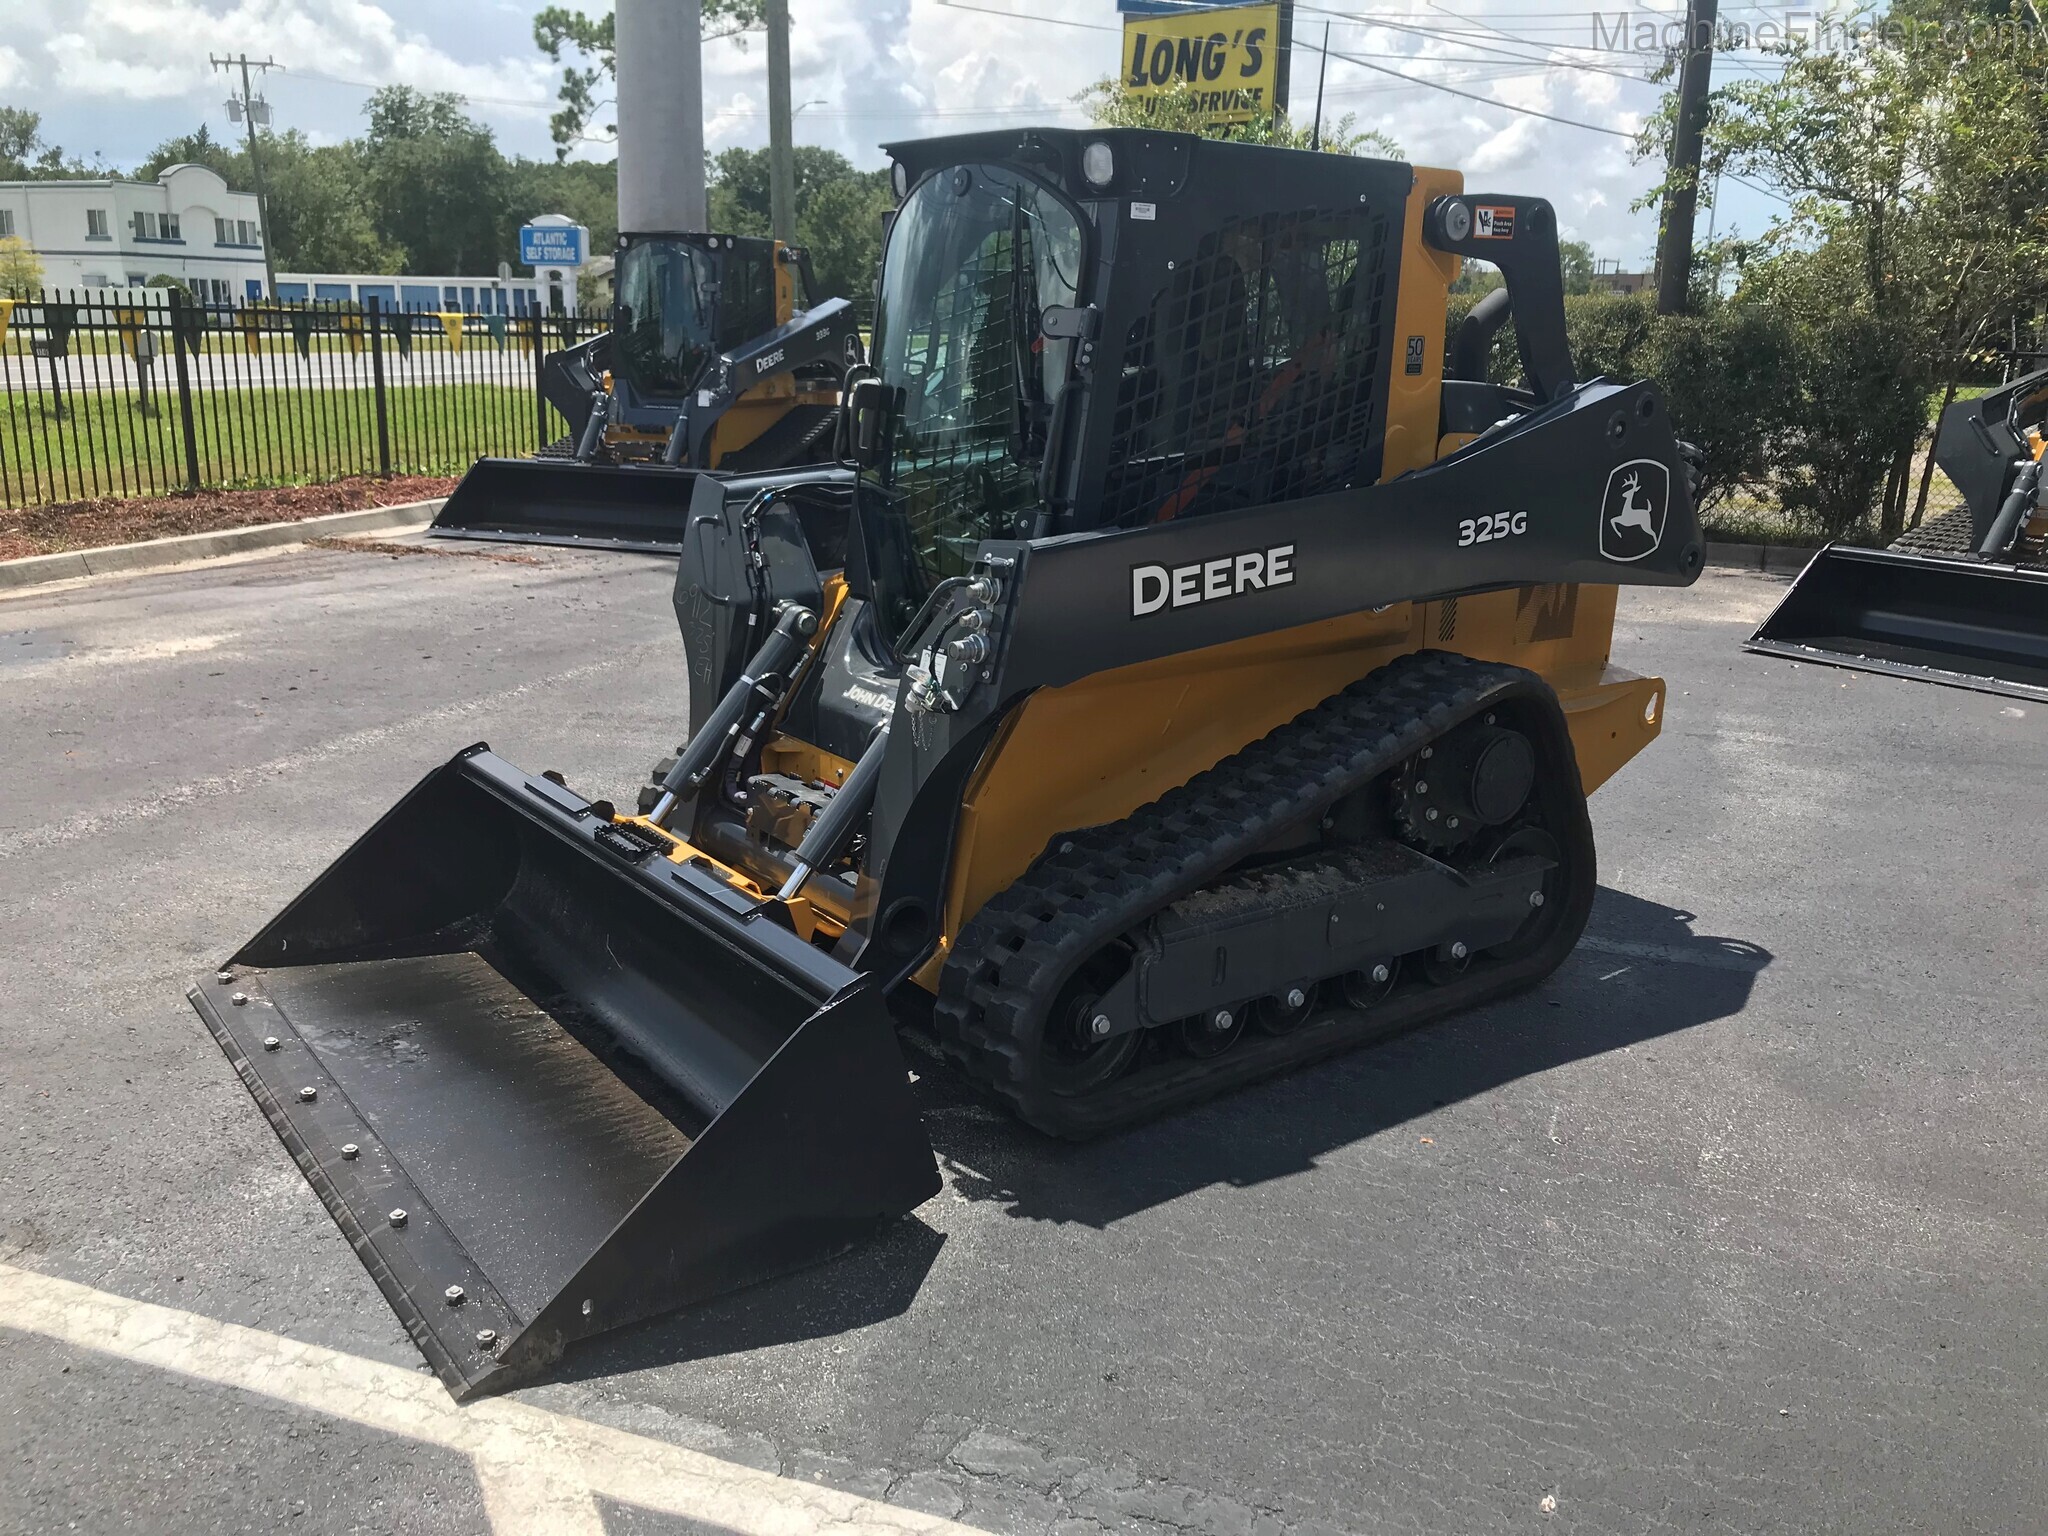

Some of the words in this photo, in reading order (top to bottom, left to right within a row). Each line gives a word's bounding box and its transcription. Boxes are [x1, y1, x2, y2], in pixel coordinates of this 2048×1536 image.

[1129, 27, 1266, 88] LONG'S
[533, 232, 568, 246] ATLANTIC
[525, 246, 542, 260] SELF
[543, 247, 576, 261] STORAGE
[1407, 338, 1424, 357] 50
[755, 348, 785, 374] DEERE
[1457, 511, 1528, 547] 325G
[1132, 544, 1295, 617] DEERE
[841, 683, 878, 705] JOHN
